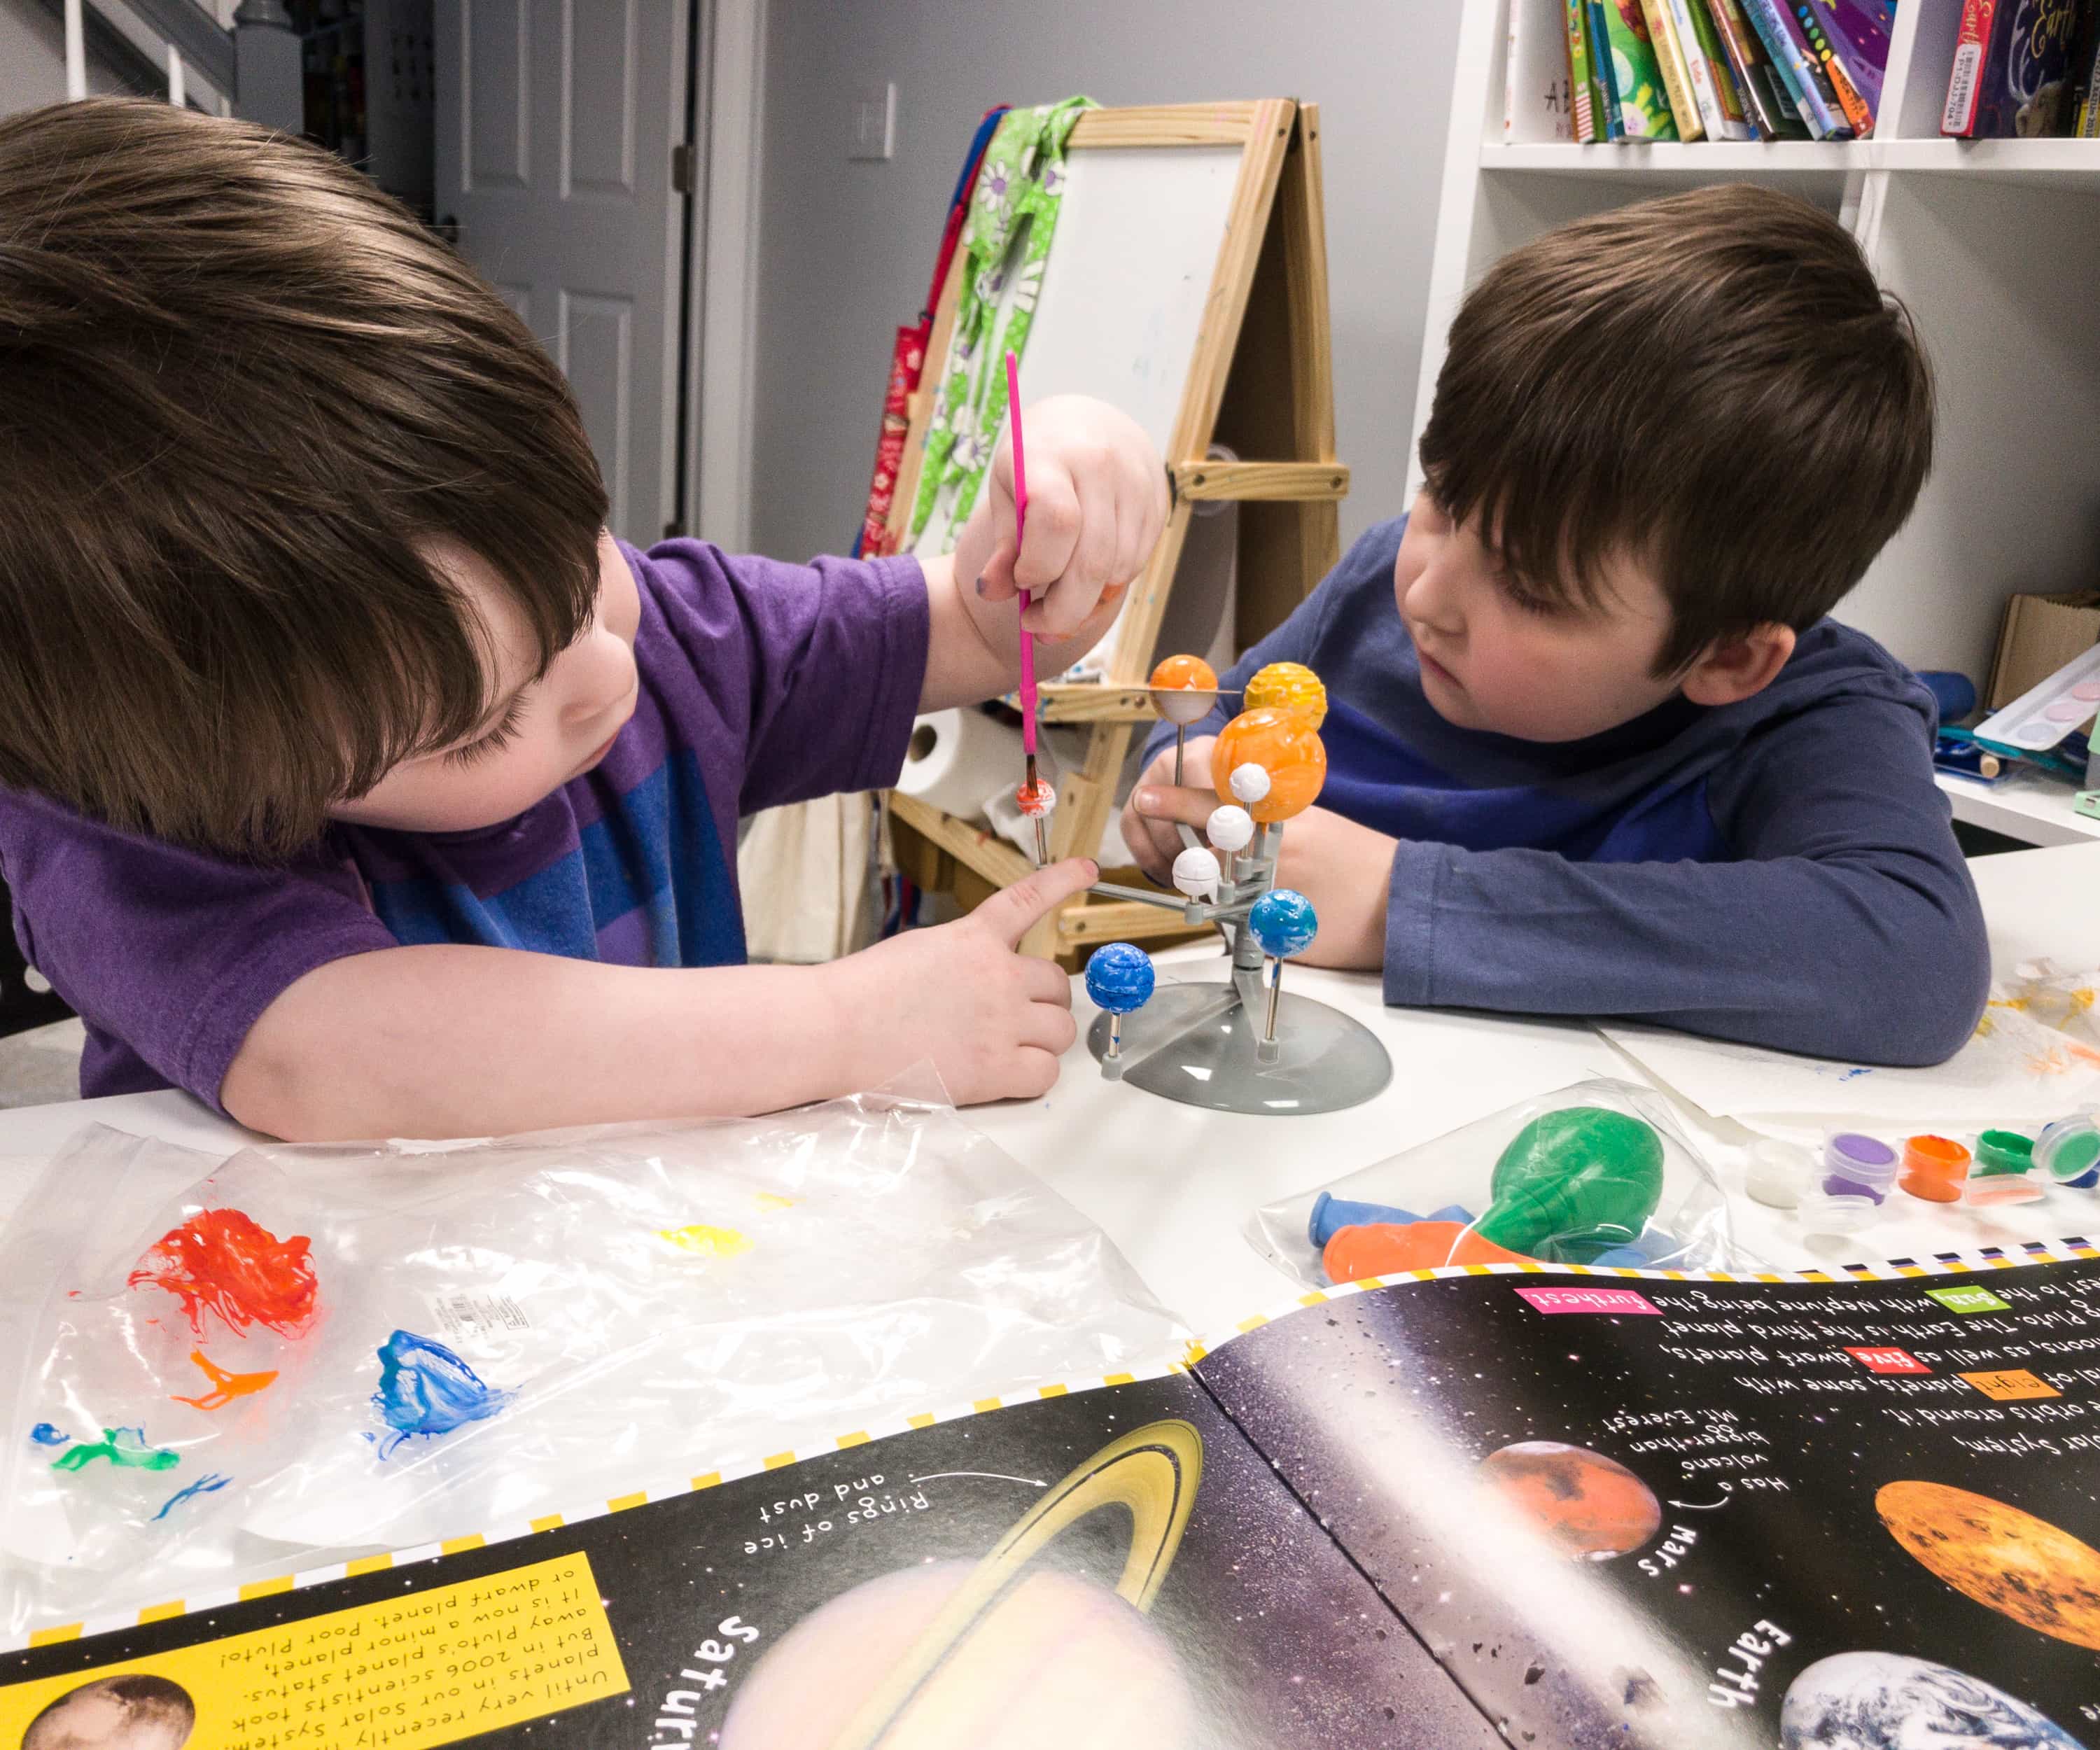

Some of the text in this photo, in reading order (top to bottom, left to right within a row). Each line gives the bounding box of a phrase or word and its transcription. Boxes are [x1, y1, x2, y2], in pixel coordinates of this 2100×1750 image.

[1933, 1292, 1997, 1306] Sun,
[1995, 1287, 2041, 1301] the
[2039, 1284, 2071, 1298] to
[1524, 1293, 1647, 1310] furthest.
[1652, 1296, 1700, 1312] the
[1690, 1290, 1778, 1314] being
[1776, 1296, 1880, 1315] Neptune
[1879, 1298, 1938, 1313] with
[1660, 1310, 2087, 1340] Pluto. The Earth is the third planet
[1658, 1344, 1769, 1366] planets,
[1776, 1350, 1852, 1367] dwarf
[1856, 1352, 1915, 1367] five
[1914, 1350, 1942, 1362] as
[1945, 1349, 2002, 1366] well
[2003, 1346, 2031, 1357] as
[1734, 1377, 1800, 1395] with
[1803, 1378, 1867, 1392] some
[1867, 1373, 1972, 1396] planets,
[1975, 1375, 2040, 1394] eight
[2043, 1372, 2073, 1390] of
[1602, 1410, 1739, 1433] Mt. Everest
[1881, 1408, 1921, 1427] it.
[1915, 1408, 2005, 1427] around
[2009, 1404, 2085, 1423] orbits
[1630, 1424, 1770, 1452] bigger than
[1952, 1432, 2061, 1457] System,
[1681, 1453, 1769, 1470] volcano
[1717, 1477, 1790, 1492] Has a
[760, 1474, 884, 1523] and dust
[744, 1492, 929, 1554] Rings of ice
[1637, 1525, 1698, 1576] Mars
[220, 1569, 574, 1669] or dwarf planet. Poor Pluto!
[265, 1588, 578, 1678] It is now a minor planet,
[244, 1608, 587, 1702] away Pluto's planet status.
[509, 1643, 599, 1681] planets
[1707, 1619, 1792, 1707] Earth
[232, 1627, 593, 1732] But in 2006 scientists took
[473, 1679, 496, 1691] in
[421, 1688, 460, 1706] our
[342, 1702, 406, 1727] Solar
[356, 1671, 608, 1747] Until very recently
